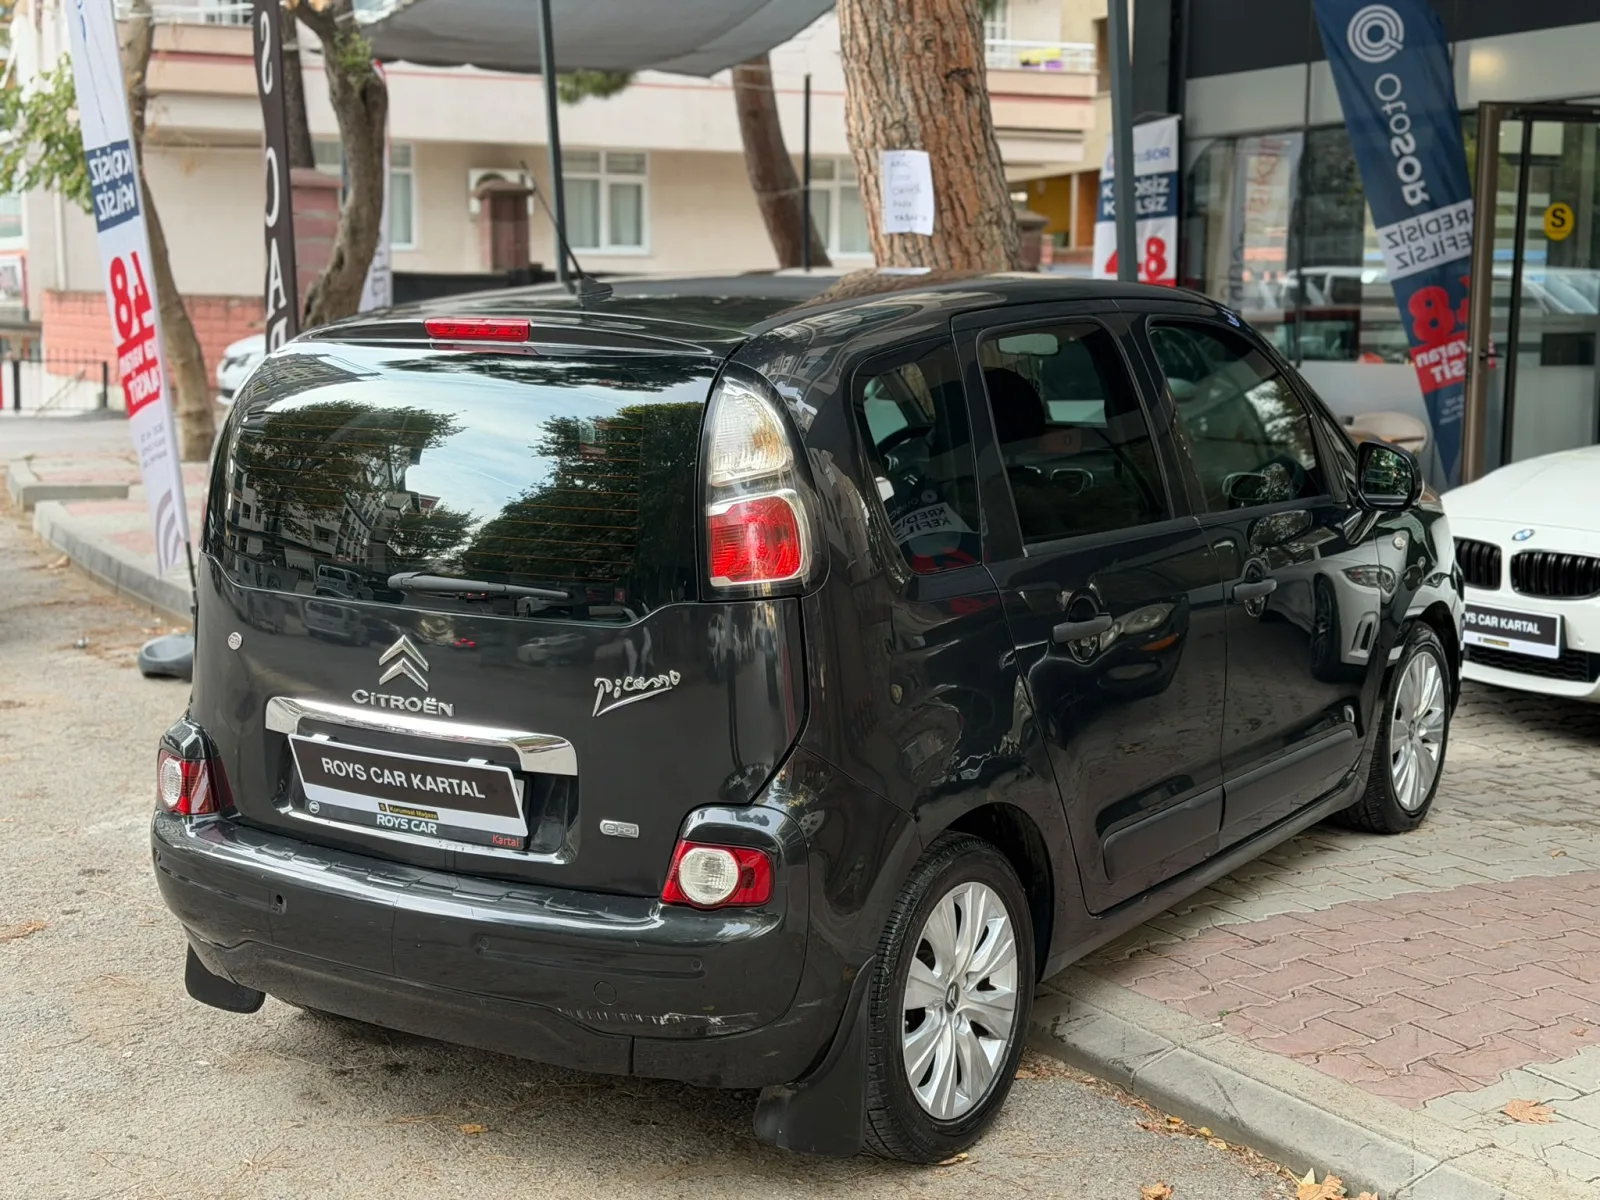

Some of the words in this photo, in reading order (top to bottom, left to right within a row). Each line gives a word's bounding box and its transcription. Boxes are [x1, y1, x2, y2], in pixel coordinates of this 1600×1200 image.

[1550, 207, 1567, 229] S
[1478, 613, 1499, 629] CAR
[1500, 618, 1542, 635] KARTAL
[592, 670, 681, 717] Picasso
[321, 757, 368, 781] ROYS
[370, 766, 408, 789] CAR
[411, 773, 486, 799] KARTAL
[376, 814, 409, 830] ROYS
[410, 820, 438, 835] CAR
[492, 834, 520, 848] Kartal
